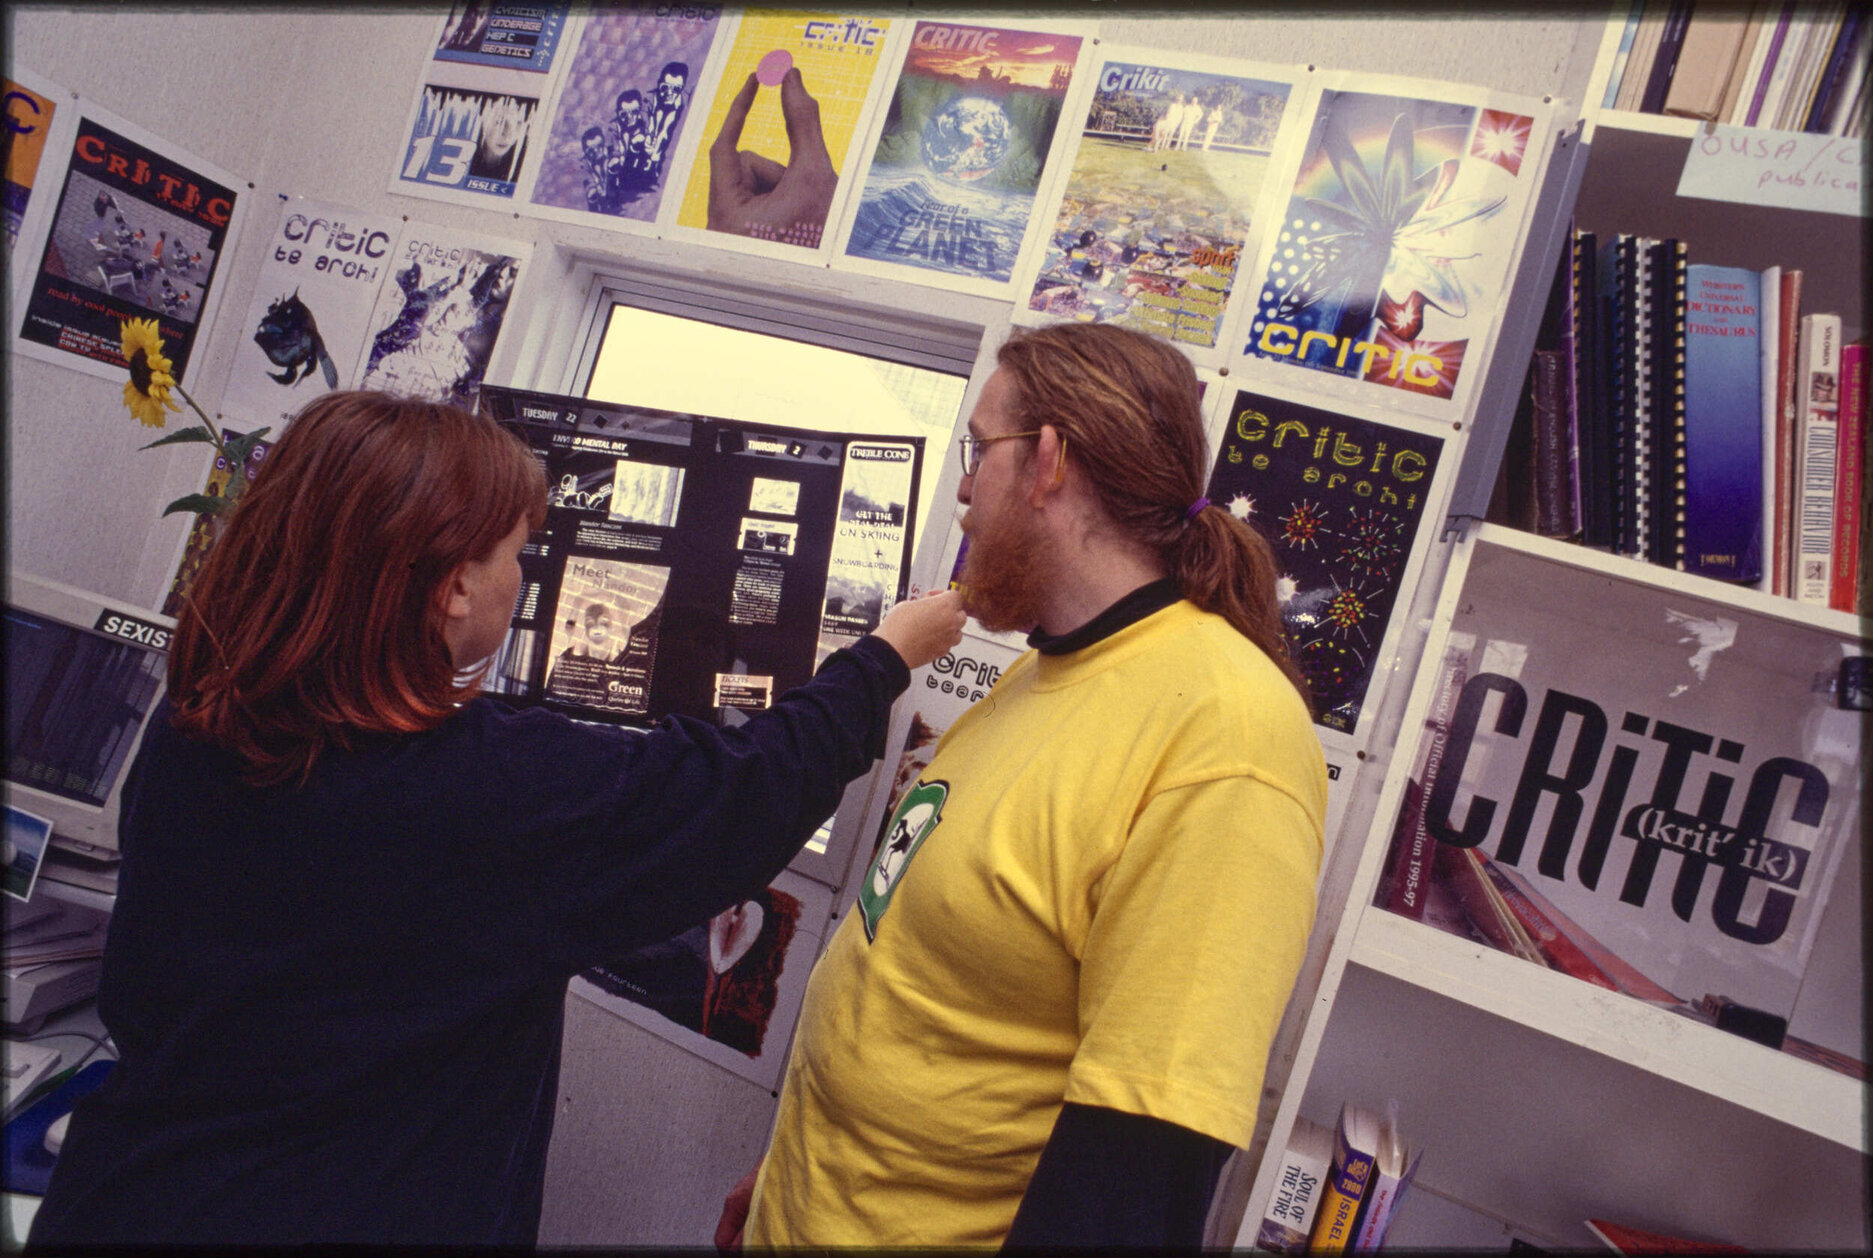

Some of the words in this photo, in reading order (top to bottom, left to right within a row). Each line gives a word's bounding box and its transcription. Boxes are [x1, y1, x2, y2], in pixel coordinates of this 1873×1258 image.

[914, 25, 1000, 53] CRITIC
[402, 135, 478, 185] 13
[76, 135, 231, 222] CRITIC
[1686, 301, 1756, 316] DICTIONARY
[1688, 321, 1757, 337] THESAURUS
[522, 407, 558, 421] TUESDAY
[565, 412, 577, 424] 22
[611, 441, 628, 452] DAY
[850, 447, 884, 459] TREBLE
[884, 449, 909, 459] CONE
[1806, 425, 1837, 492] CONSUMER
[860, 530, 900, 543] SKIING
[1801, 495, 1834, 555] BEHAVIOR
[572, 564, 612, 580] Meet
[607, 681, 643, 696] Green
[1403, 860, 1422, 908] 1995-97
[1282, 1165, 1302, 1190] THE
[1293, 1173, 1318, 1204] SOUL
[1273, 1189, 1294, 1220] FIRE
[1289, 1205, 1305, 1225] OF
[1328, 1197, 1352, 1241] ISRAEL
